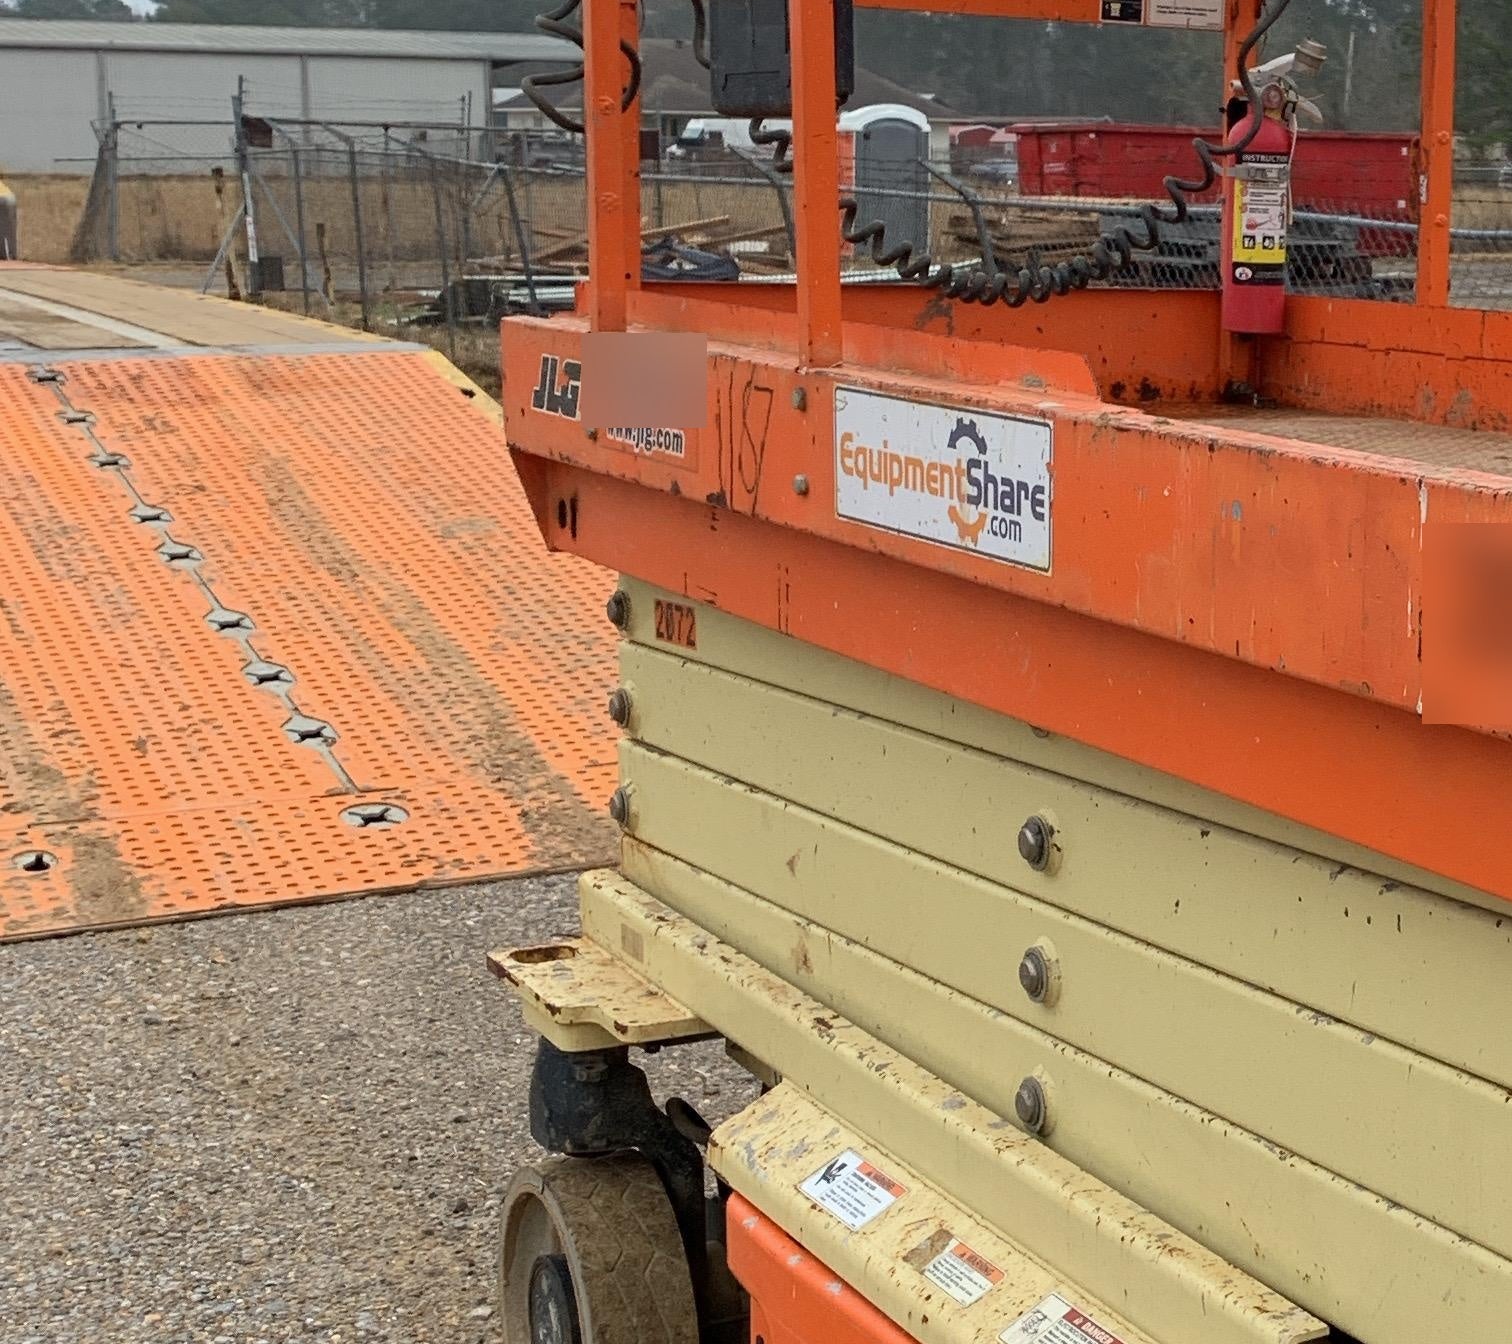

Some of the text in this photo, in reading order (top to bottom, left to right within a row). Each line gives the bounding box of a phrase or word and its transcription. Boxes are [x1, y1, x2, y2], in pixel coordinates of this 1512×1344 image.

[531, 353, 582, 422] JLG
[839, 431, 1046, 523] EquipmentShare
[987, 515, 1023, 544] .com
[655, 599, 696, 647] 2072
